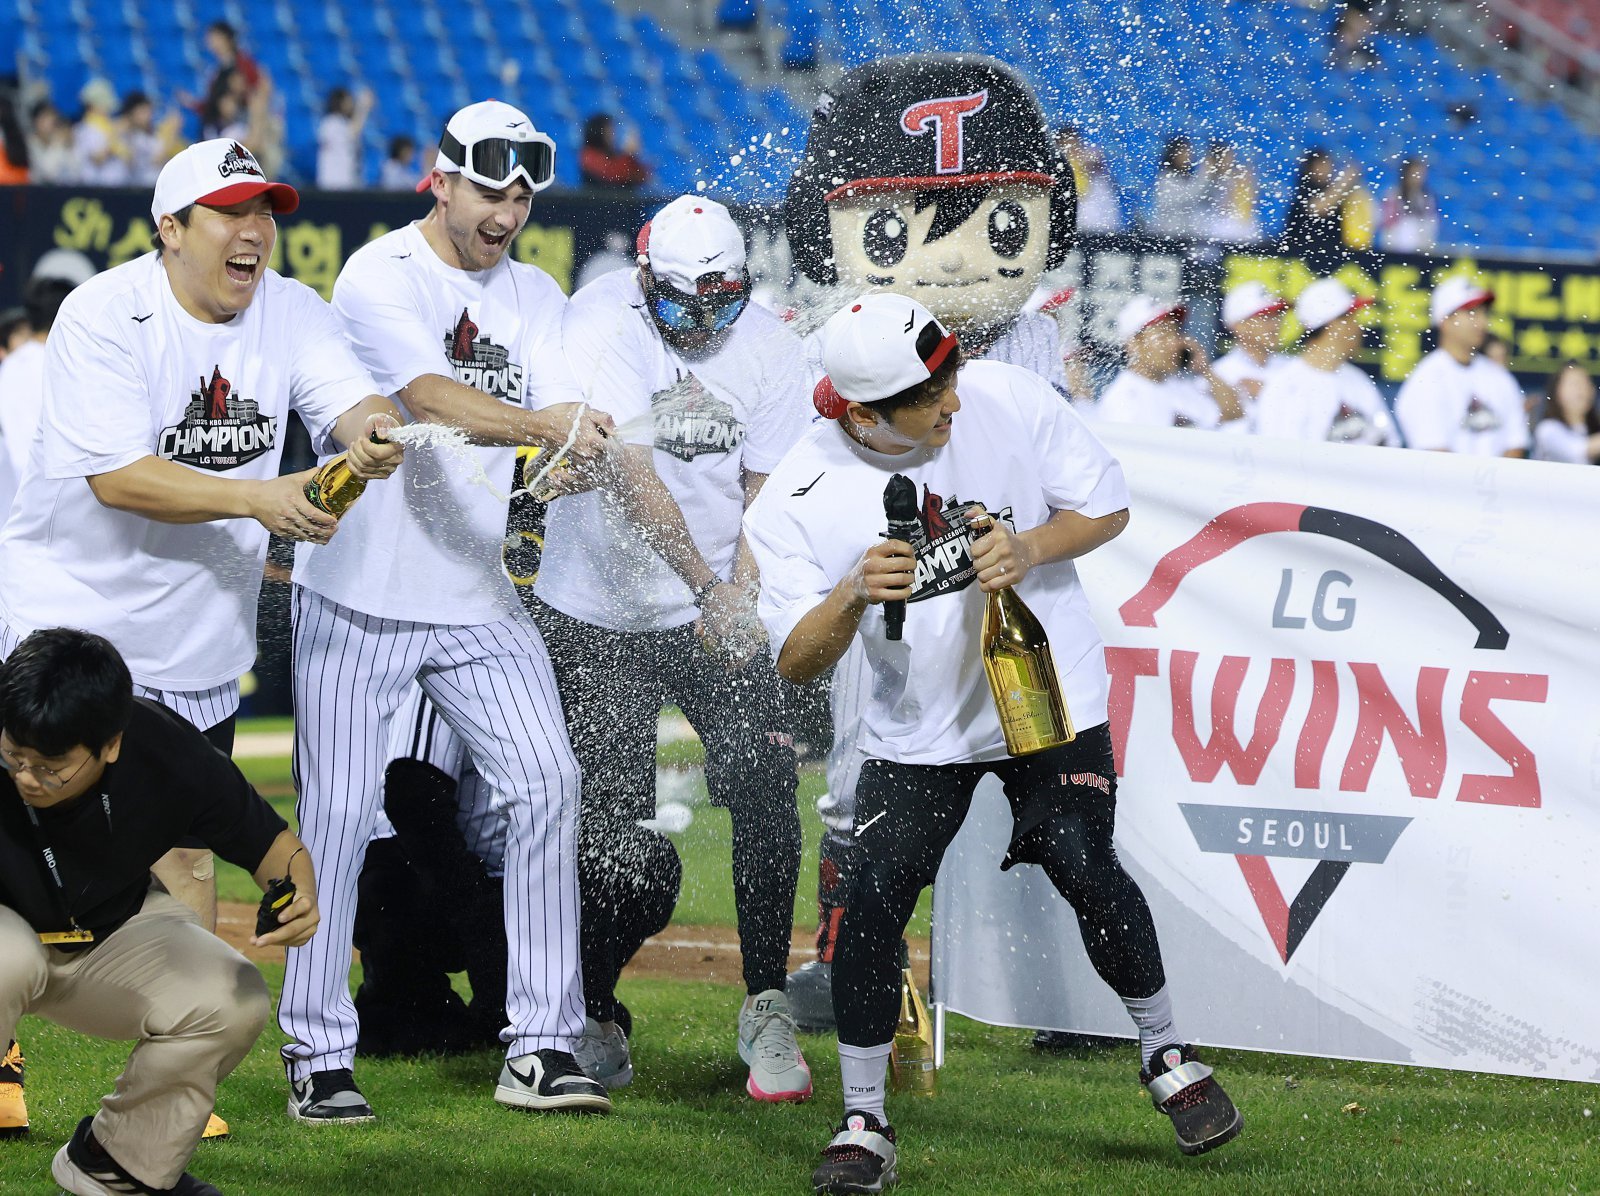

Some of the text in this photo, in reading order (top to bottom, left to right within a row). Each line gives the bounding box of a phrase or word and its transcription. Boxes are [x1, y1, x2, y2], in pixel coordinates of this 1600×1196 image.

[901, 88, 989, 174] T
[199, 456, 211, 464] LG
[937, 579, 950, 591] LG
[1272, 568, 1357, 632] LG
[1104, 646, 1549, 808] TWINS
[1057, 772, 1110, 796] TWINS
[101, 793, 111, 815] KBO
[1237, 817, 1353, 851] SEOUL
[42, 847, 57, 869] KBO
[756, 999, 774, 1012] GT
